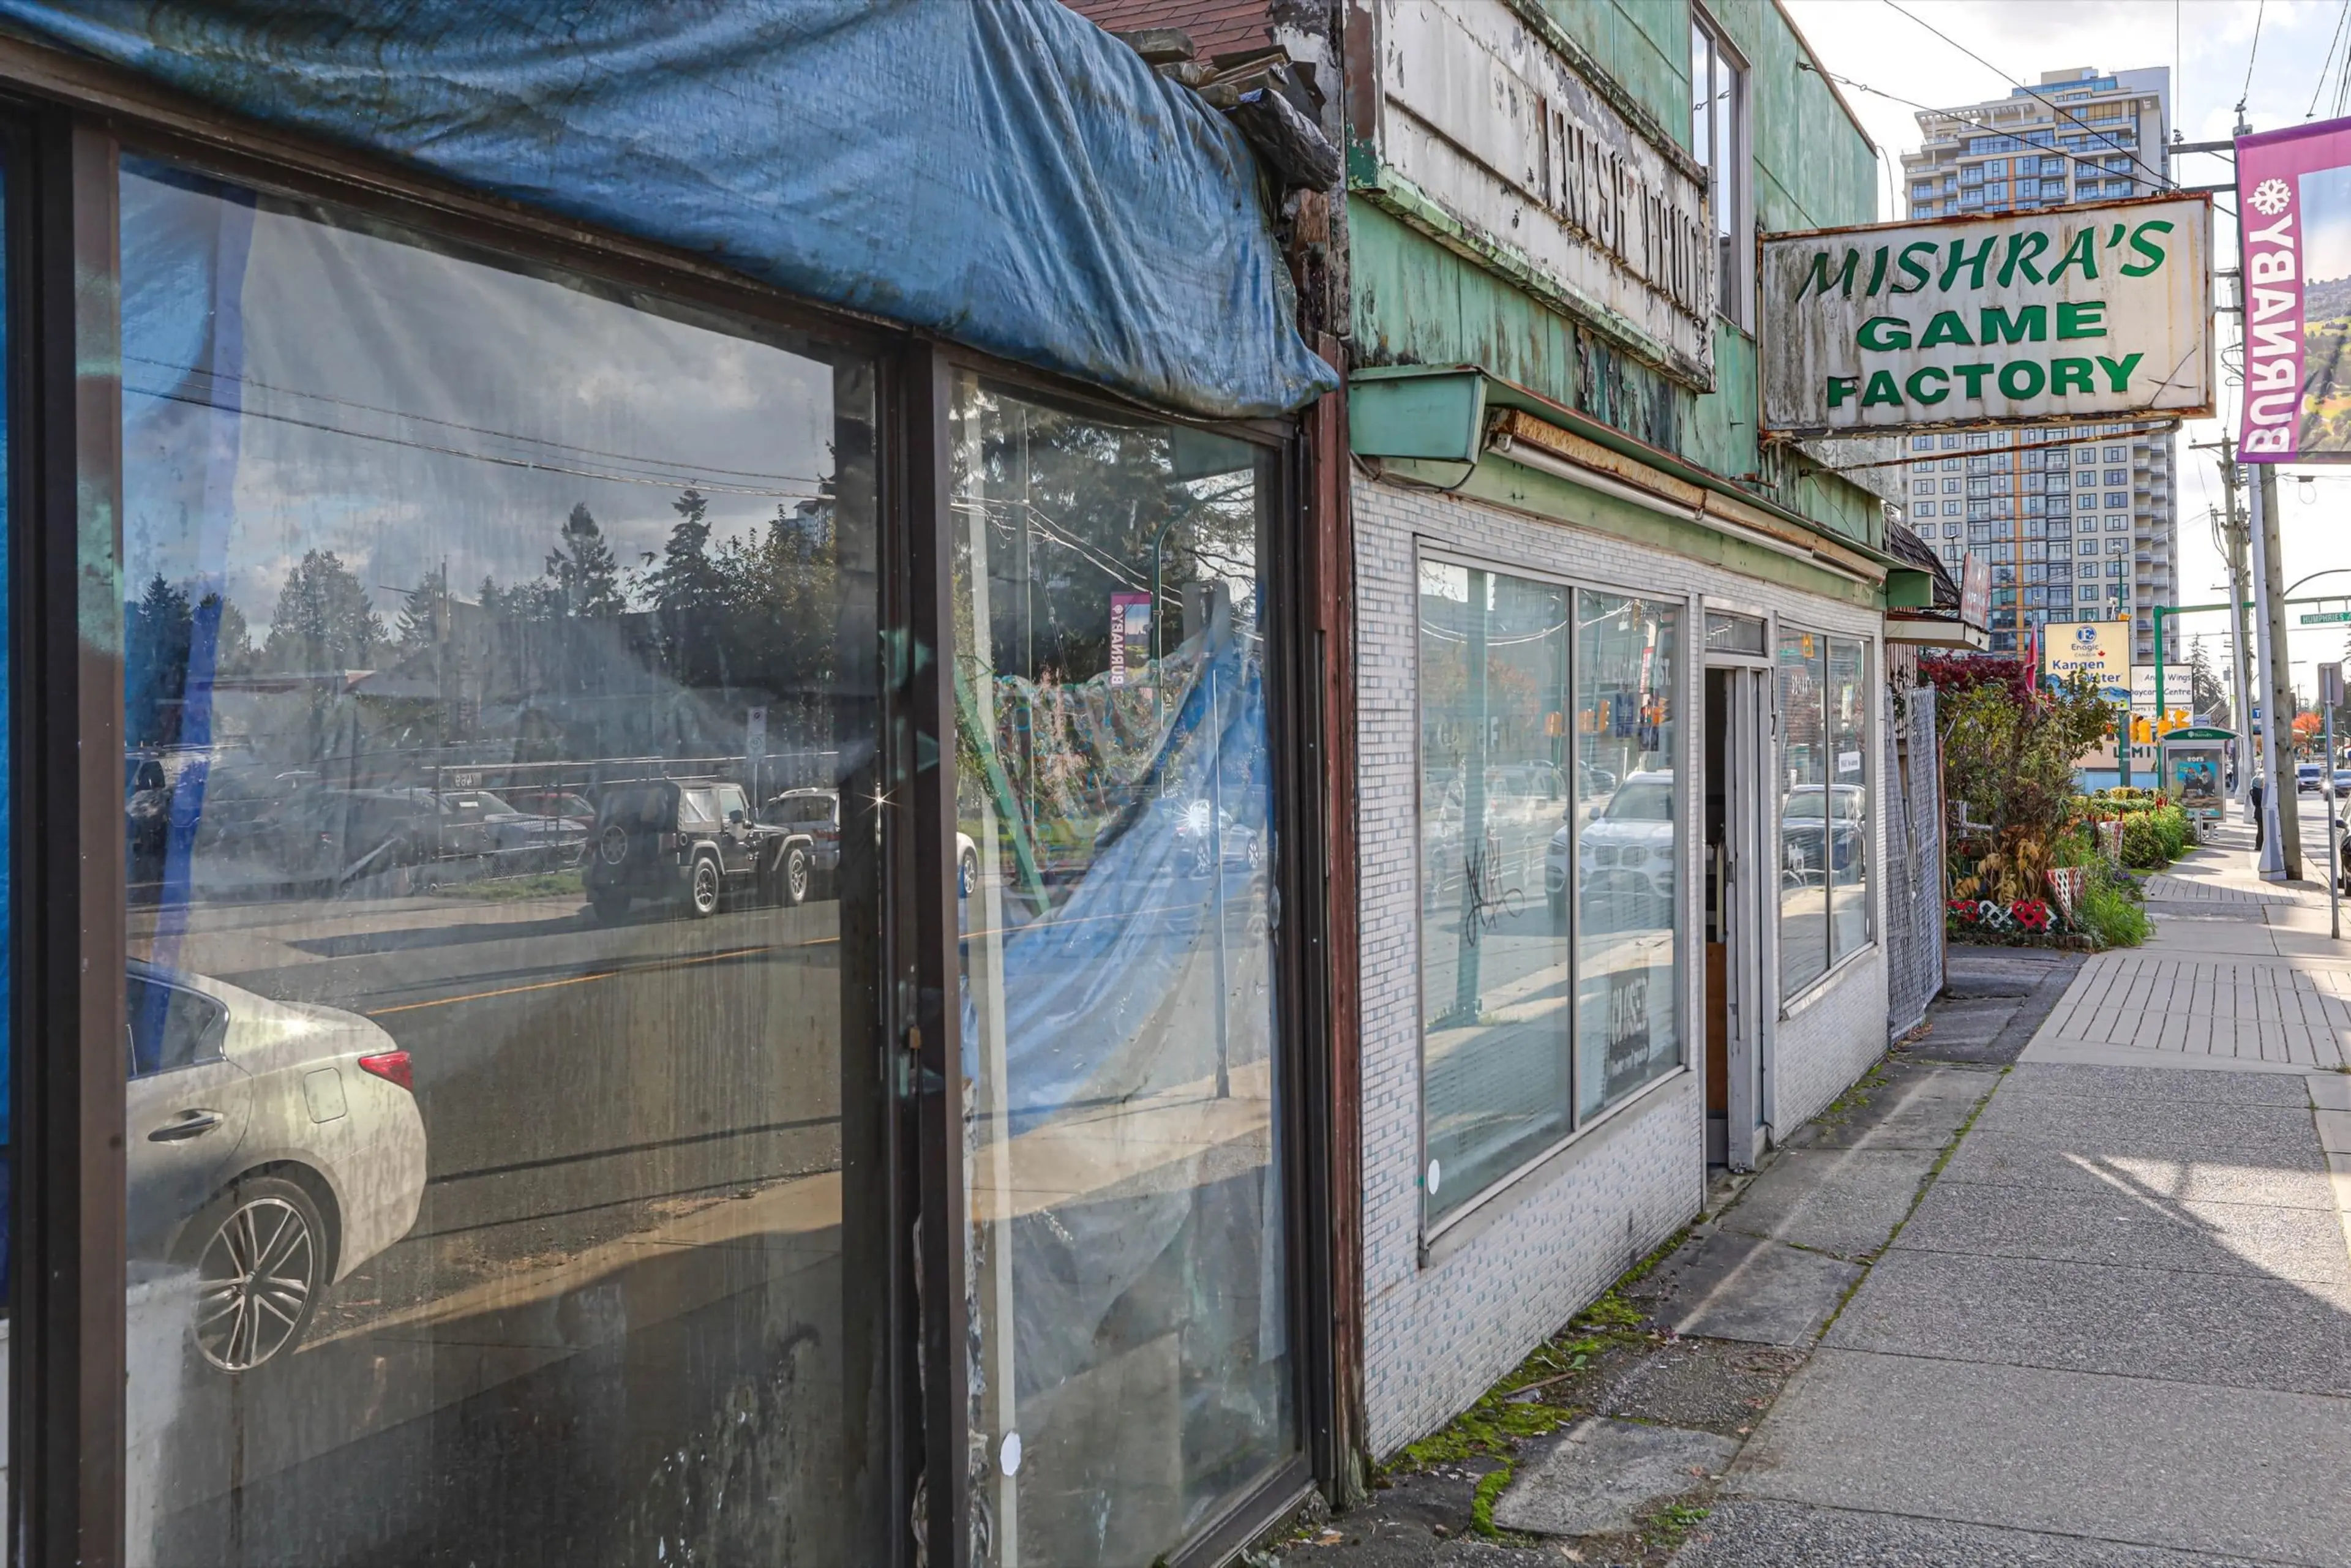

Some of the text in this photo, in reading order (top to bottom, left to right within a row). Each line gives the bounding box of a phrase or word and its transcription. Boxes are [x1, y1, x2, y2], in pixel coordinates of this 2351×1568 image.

[1795, 220, 2174, 302] MISHRA'S
[1856, 301, 2107, 351] GAME
[1827, 353, 2144, 407] FACTORY
[2303, 613, 2344, 623] HUMPHRIES
[2053, 660, 2105, 672] Kangen
[2168, 673, 2191, 683] Wings
